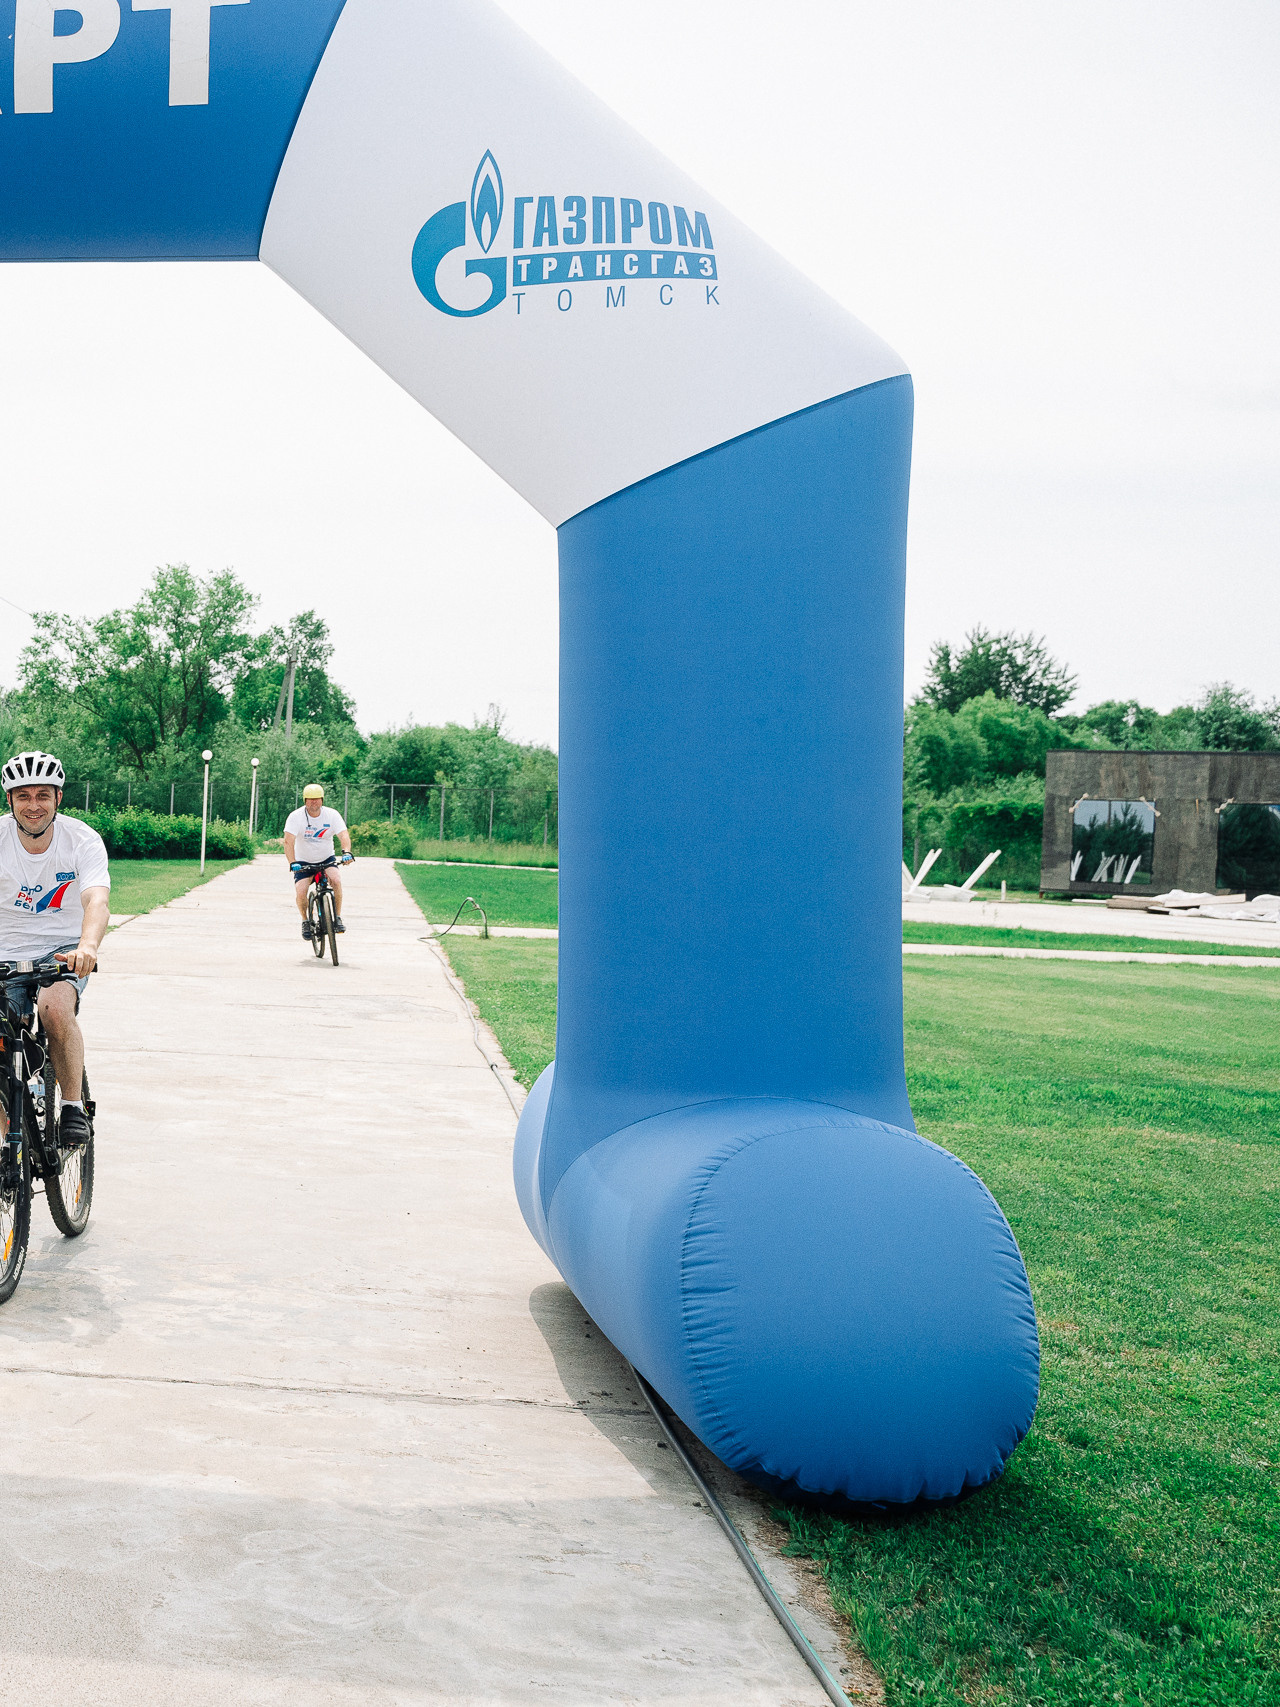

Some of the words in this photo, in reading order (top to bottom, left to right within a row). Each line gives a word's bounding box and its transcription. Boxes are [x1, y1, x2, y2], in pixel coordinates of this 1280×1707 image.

[513, 195, 714, 250] ГАЗПРОМ
[517, 253, 714, 282] ТРАНСГАЗ
[512, 284, 720, 315] ТОМСК
